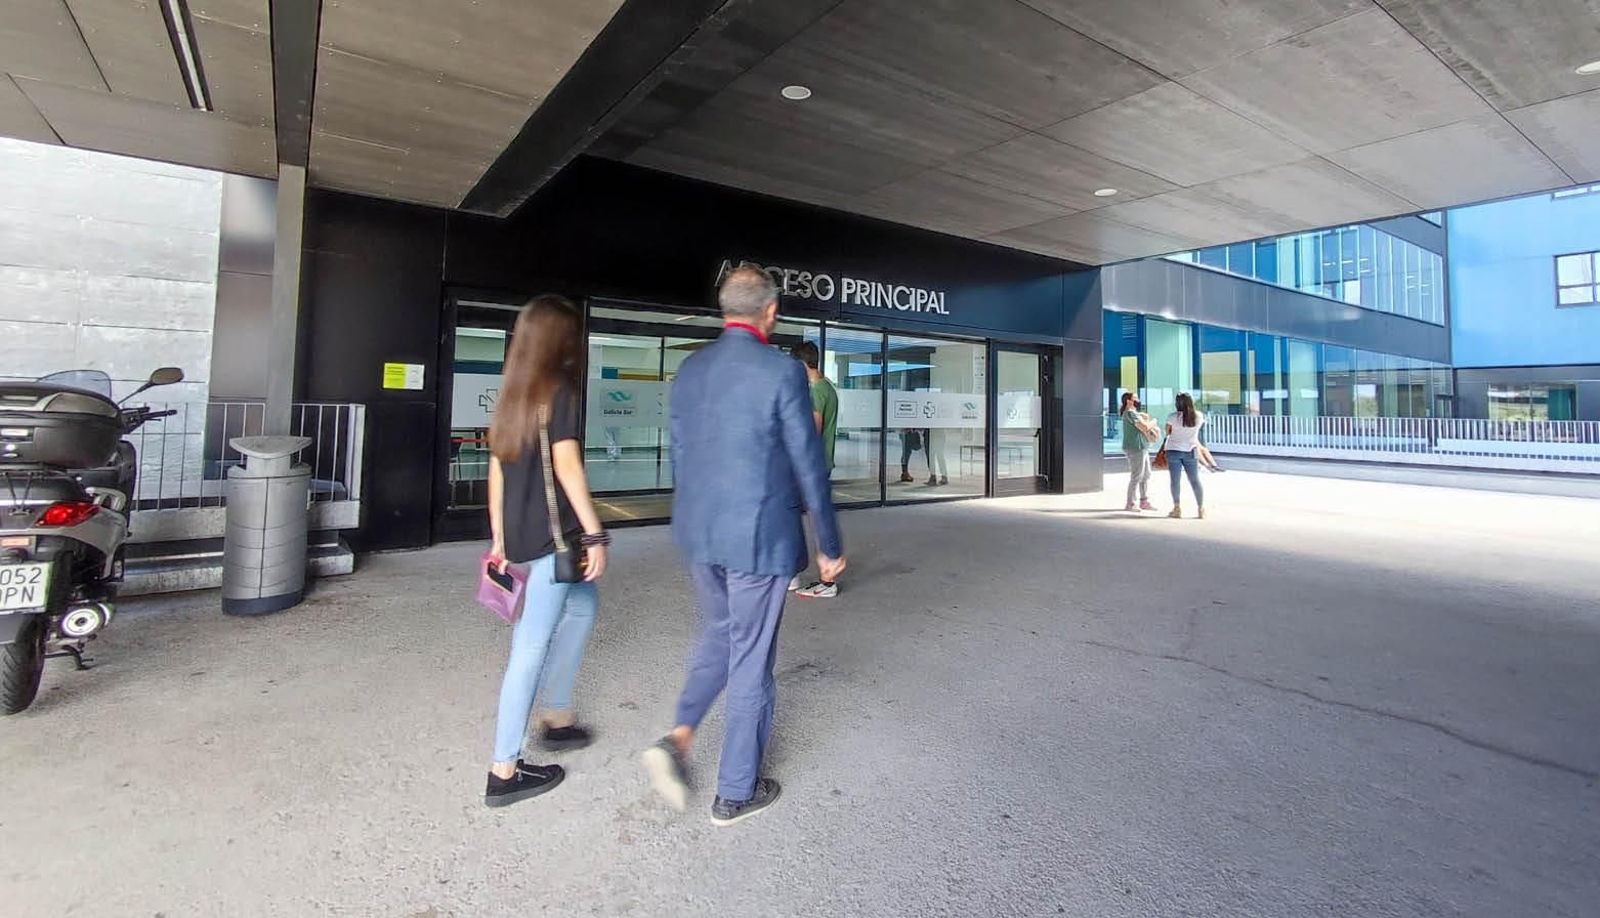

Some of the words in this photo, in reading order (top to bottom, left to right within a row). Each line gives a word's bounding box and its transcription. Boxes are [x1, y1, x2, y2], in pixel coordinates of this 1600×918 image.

[714, 259, 835, 301] ACESO
[841, 277, 949, 314] PRINCIPAL
[0, 586, 35, 606] PN
